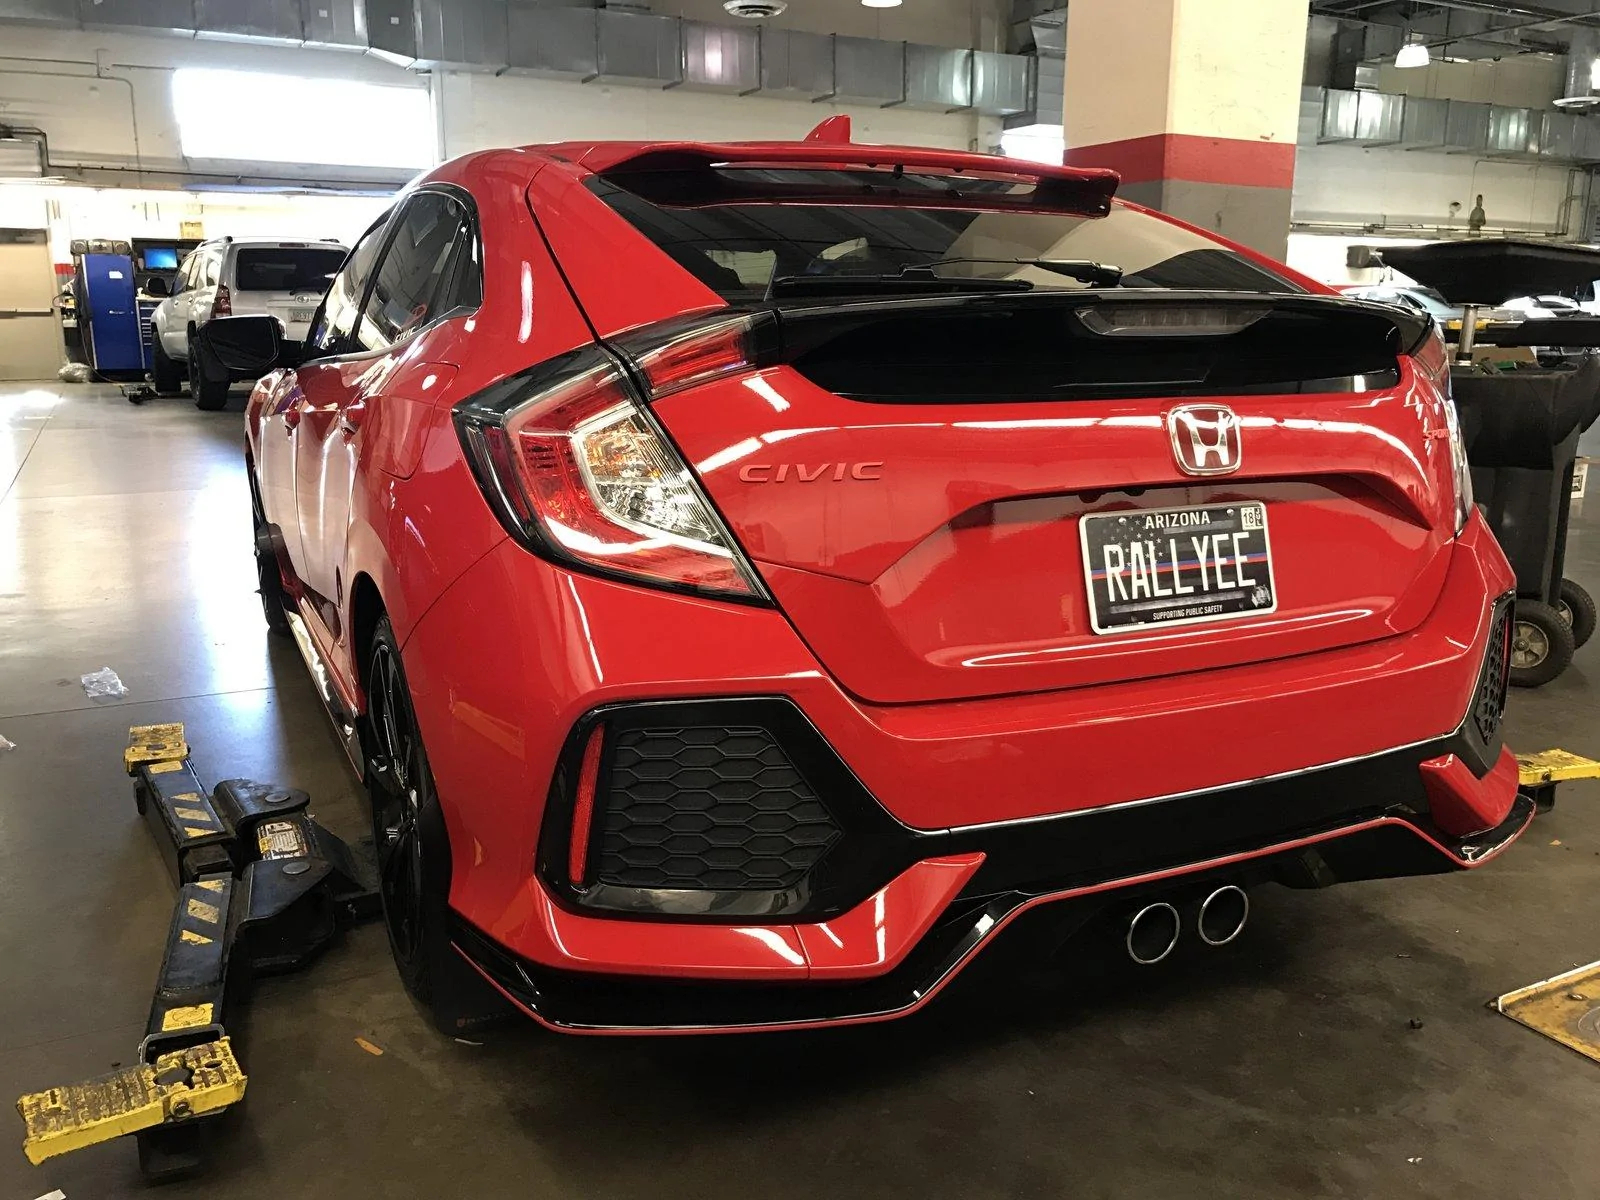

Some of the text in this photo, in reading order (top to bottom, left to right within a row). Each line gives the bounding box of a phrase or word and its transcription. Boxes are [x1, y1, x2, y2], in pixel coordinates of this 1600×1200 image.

[738, 461, 884, 483] CIVIC
[1145, 511, 1211, 530] ARIZONA
[1243, 512, 1254, 525] 18
[1103, 532, 1256, 602] RALLYEE
[1152, 604, 1223, 621] SUPPORTING PUBLIC SAFETY
